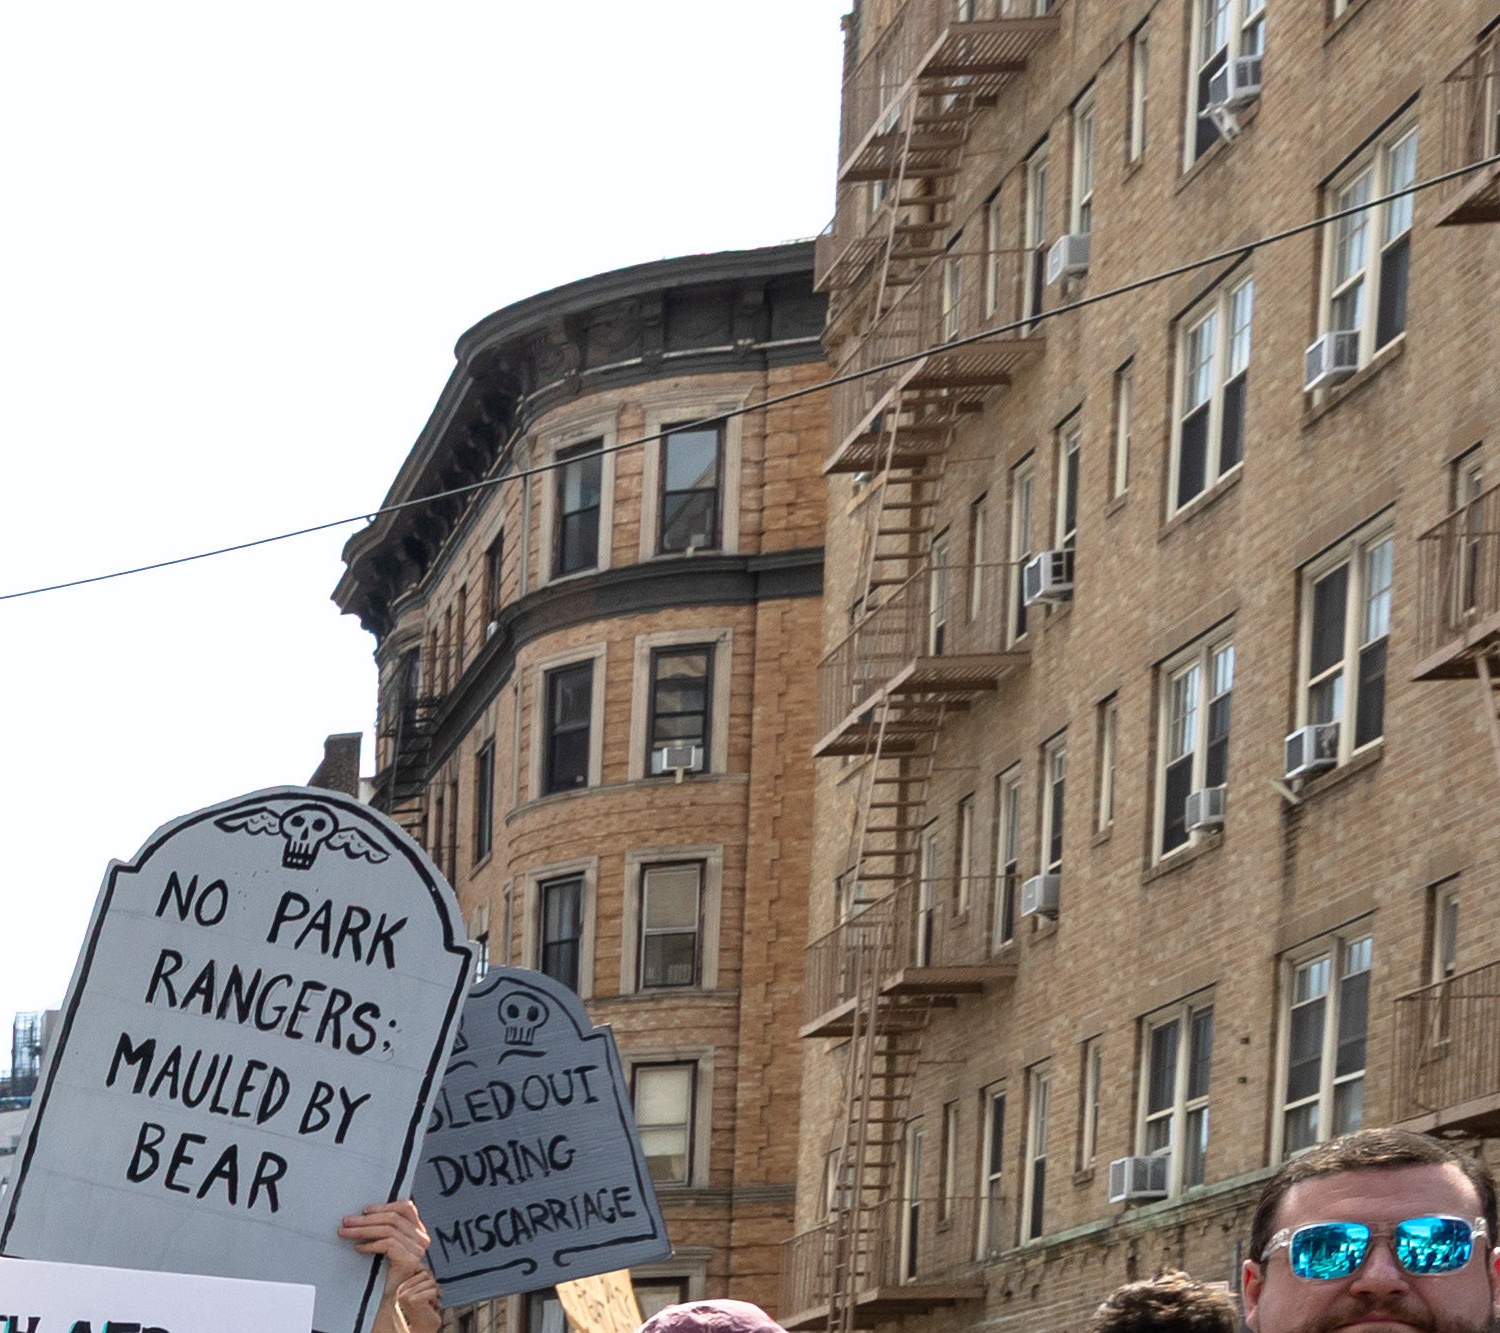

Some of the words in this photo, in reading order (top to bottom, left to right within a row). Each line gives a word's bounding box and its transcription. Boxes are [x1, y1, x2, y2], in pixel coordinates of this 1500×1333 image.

[155, 870, 229, 927] NO
[266, 890, 408, 969] PARK
[106, 1031, 290, 1125] MAULED
[298, 1080, 371, 1144] BY
[126, 1121, 288, 1213] BEAR
[427, 1134, 576, 1197] DURING
[435, 1186, 636, 1263] MISCARRIAGE
